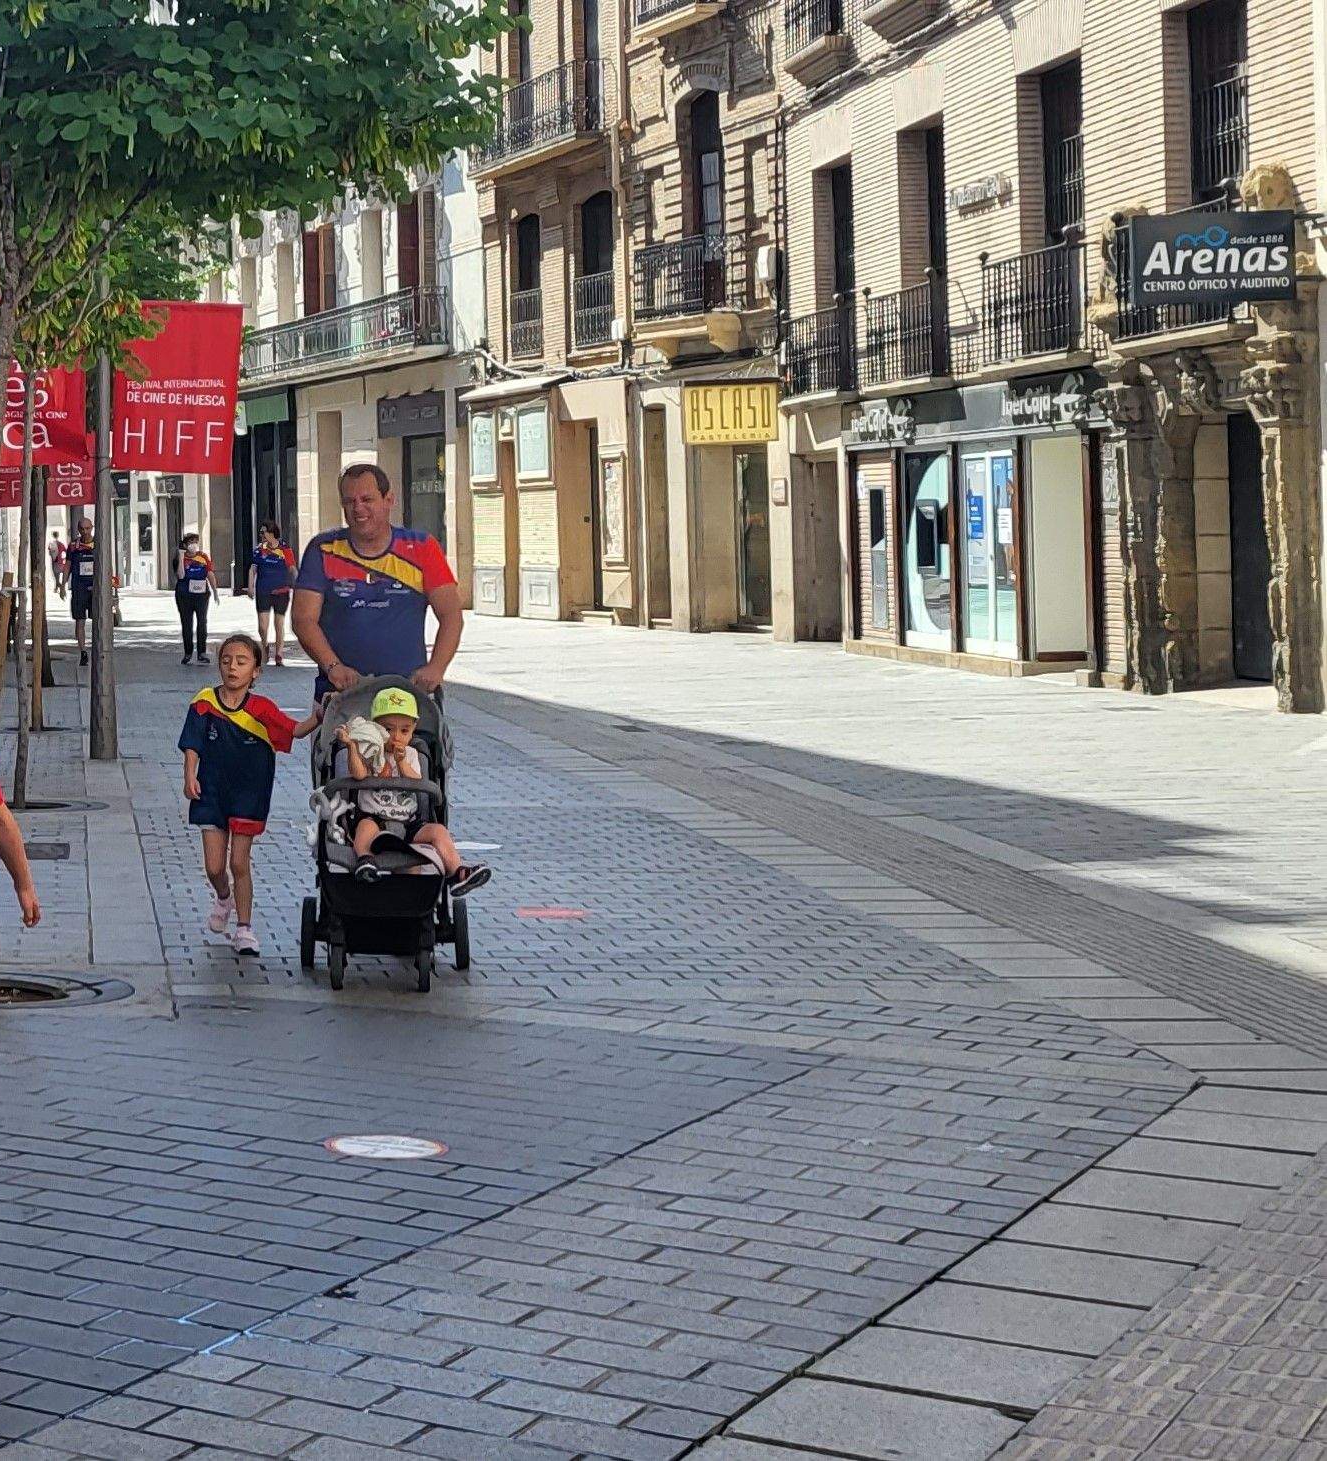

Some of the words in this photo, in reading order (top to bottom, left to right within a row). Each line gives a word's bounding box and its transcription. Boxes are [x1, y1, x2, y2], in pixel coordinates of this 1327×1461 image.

[1230, 236, 1257, 244] desde
[1143, 241, 1289, 276] Arenas
[1143, 280, 1185, 292] CENTRO
[1188, 277, 1227, 291] ÓPTICO
[1230, 278, 1238, 289] Y
[1240, 277, 1290, 289] AUDITIVO
[127, 380, 162, 389] FESTIVAL
[164, 379, 226, 388] INTERNACIONAL
[126, 391, 140, 403] DE
[143, 392, 166, 404] CINE
[168, 393, 182, 404] DE
[184, 394, 225, 407] HUESCA
[691, 387, 771, 430] ASCASO
[2, 421, 52, 449] ca
[124, 418, 225, 457] HIFF
[57, 482, 84, 498] ca
